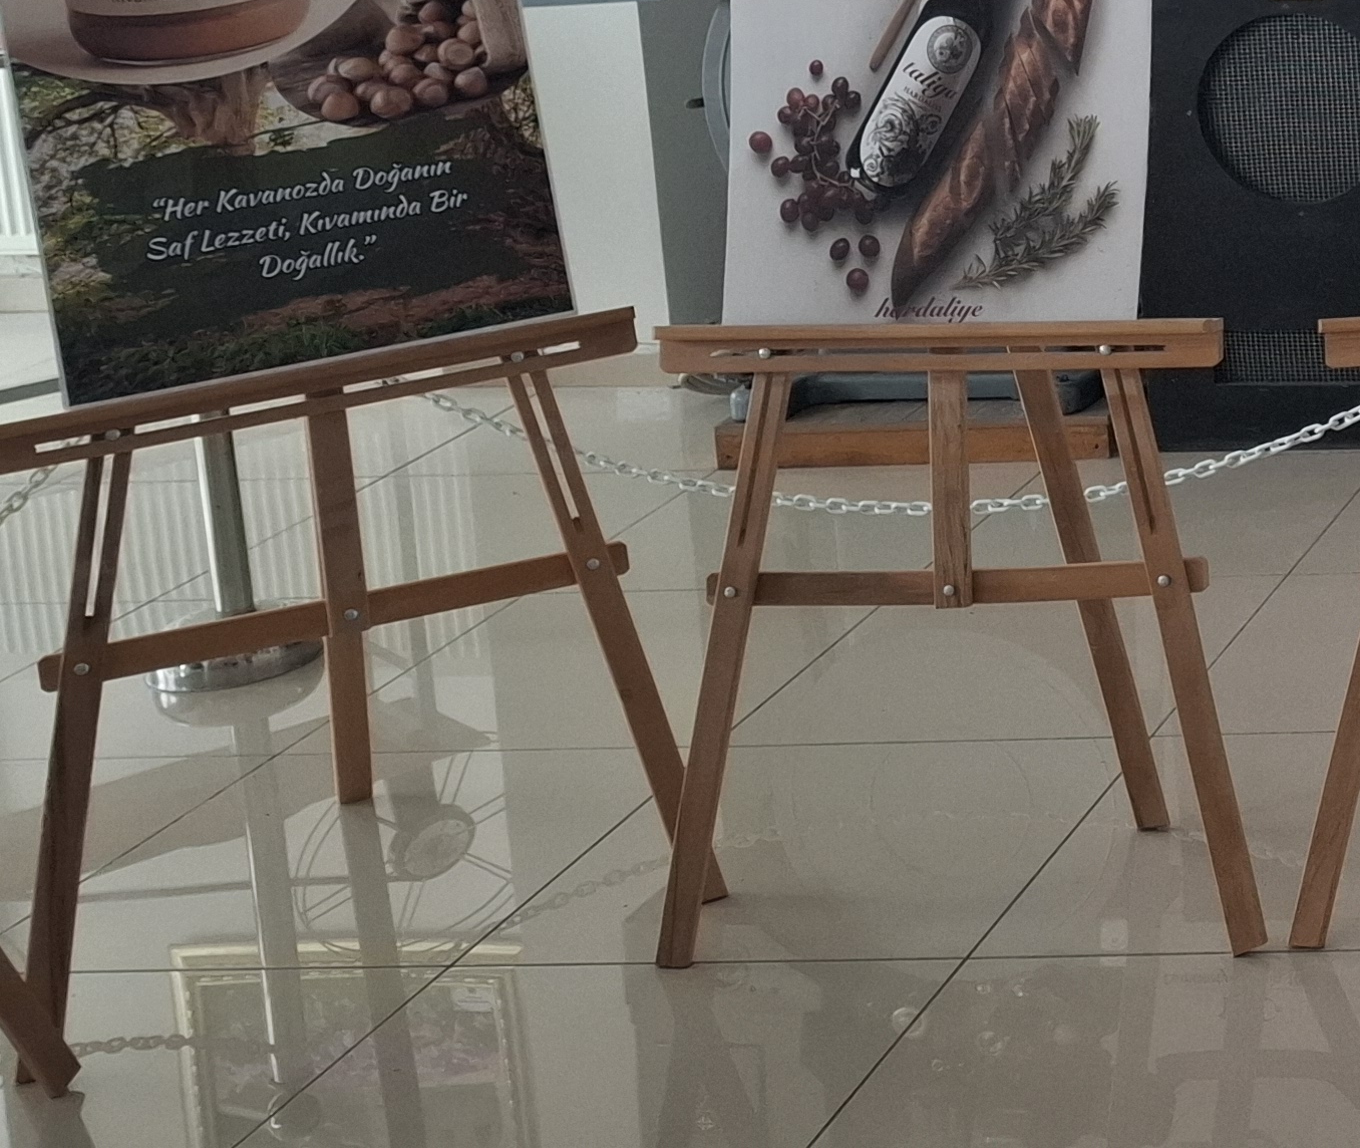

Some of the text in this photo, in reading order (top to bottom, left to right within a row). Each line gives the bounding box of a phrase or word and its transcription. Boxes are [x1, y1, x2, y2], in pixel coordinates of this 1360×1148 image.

[216, 171, 345, 213] Kavanozda
[353, 160, 452, 192] Doğanın
[146, 189, 468, 260] Saf Lezzeti, Kıvamında Bir
